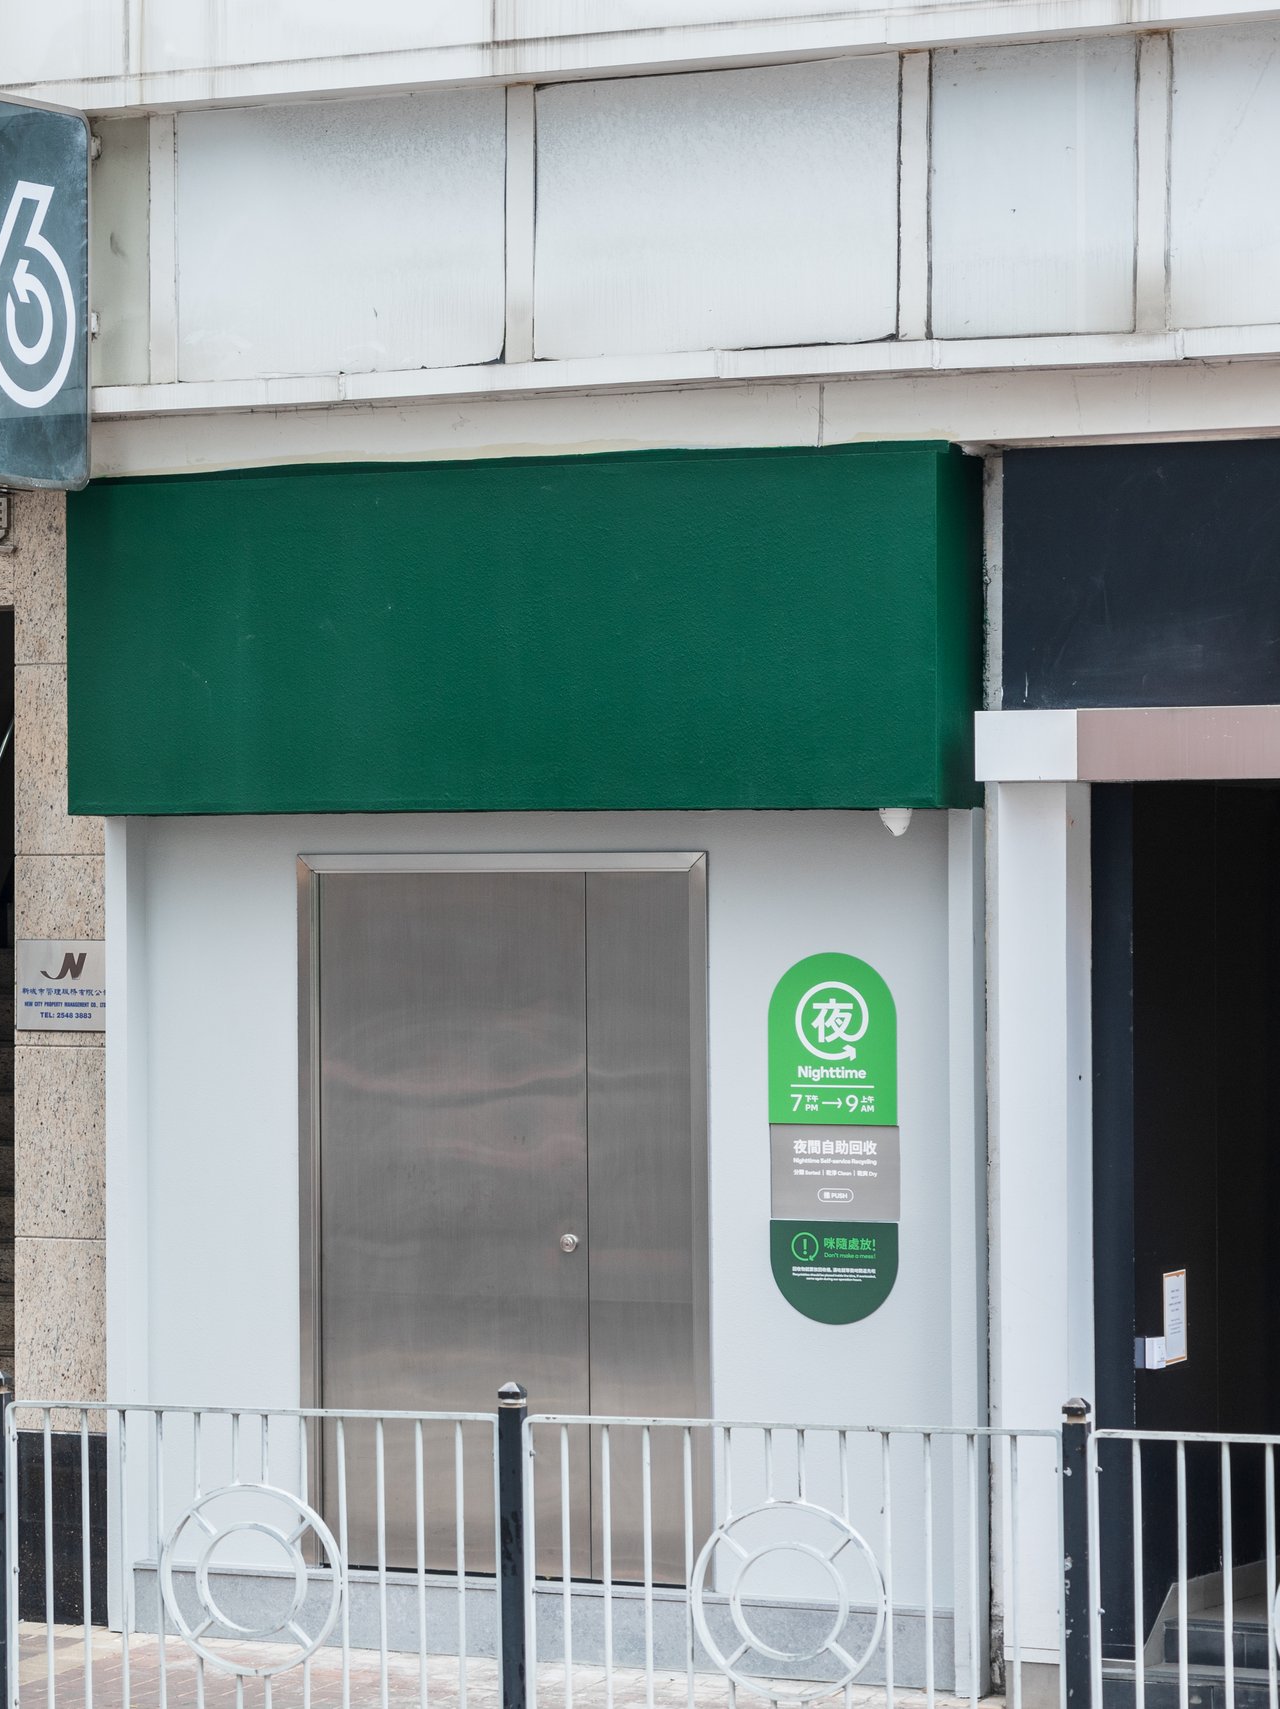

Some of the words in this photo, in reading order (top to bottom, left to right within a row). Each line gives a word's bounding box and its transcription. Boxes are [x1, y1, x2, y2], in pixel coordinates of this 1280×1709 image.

[797, 1065, 867, 1081] Nighttime
[790, 1094, 802, 1112] 7
[805, 1094, 819, 1103] 下午
[845, 1094, 858, 1113] 9
[860, 1096, 875, 1104] 上午
[805, 1104, 819, 1112] PM
[860, 1105, 875, 1113] AM
[793, 1138, 878, 1155] 夜間自助回收
[793, 1157, 820, 1165] Nighttime
[820, 1157, 851, 1165] Self-service
[851, 1158, 878, 1166] Recycling
